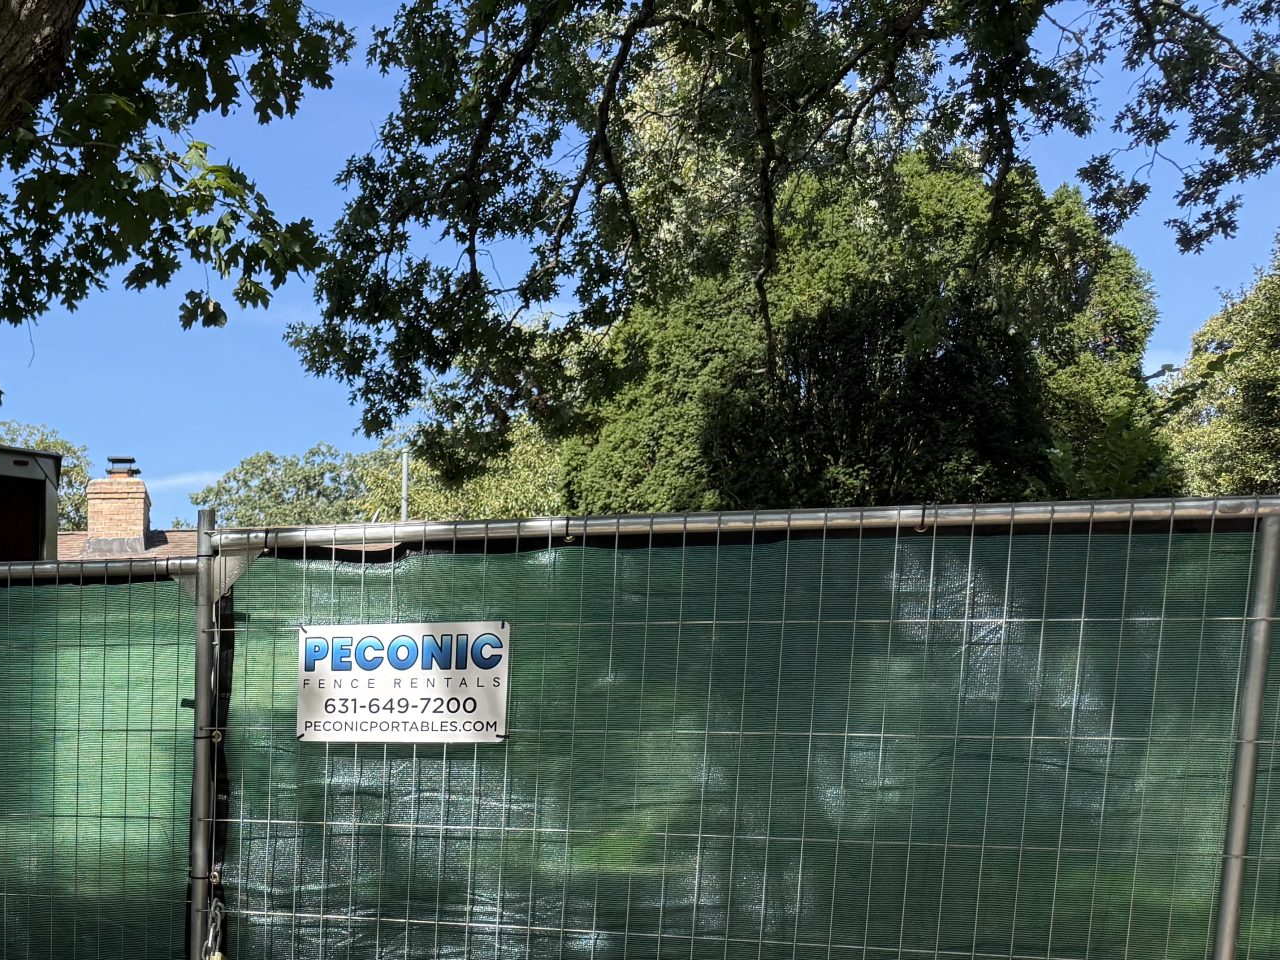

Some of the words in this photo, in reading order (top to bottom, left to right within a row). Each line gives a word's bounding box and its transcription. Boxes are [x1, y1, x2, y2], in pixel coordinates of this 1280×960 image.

[304, 633, 503, 672] PECONIC
[303, 678, 376, 689] FENCE
[394, 676, 501, 688] RENTALS
[324, 697, 477, 714] 631-649-7200
[304, 720, 498, 732] PECONICPORTABLES.COM
